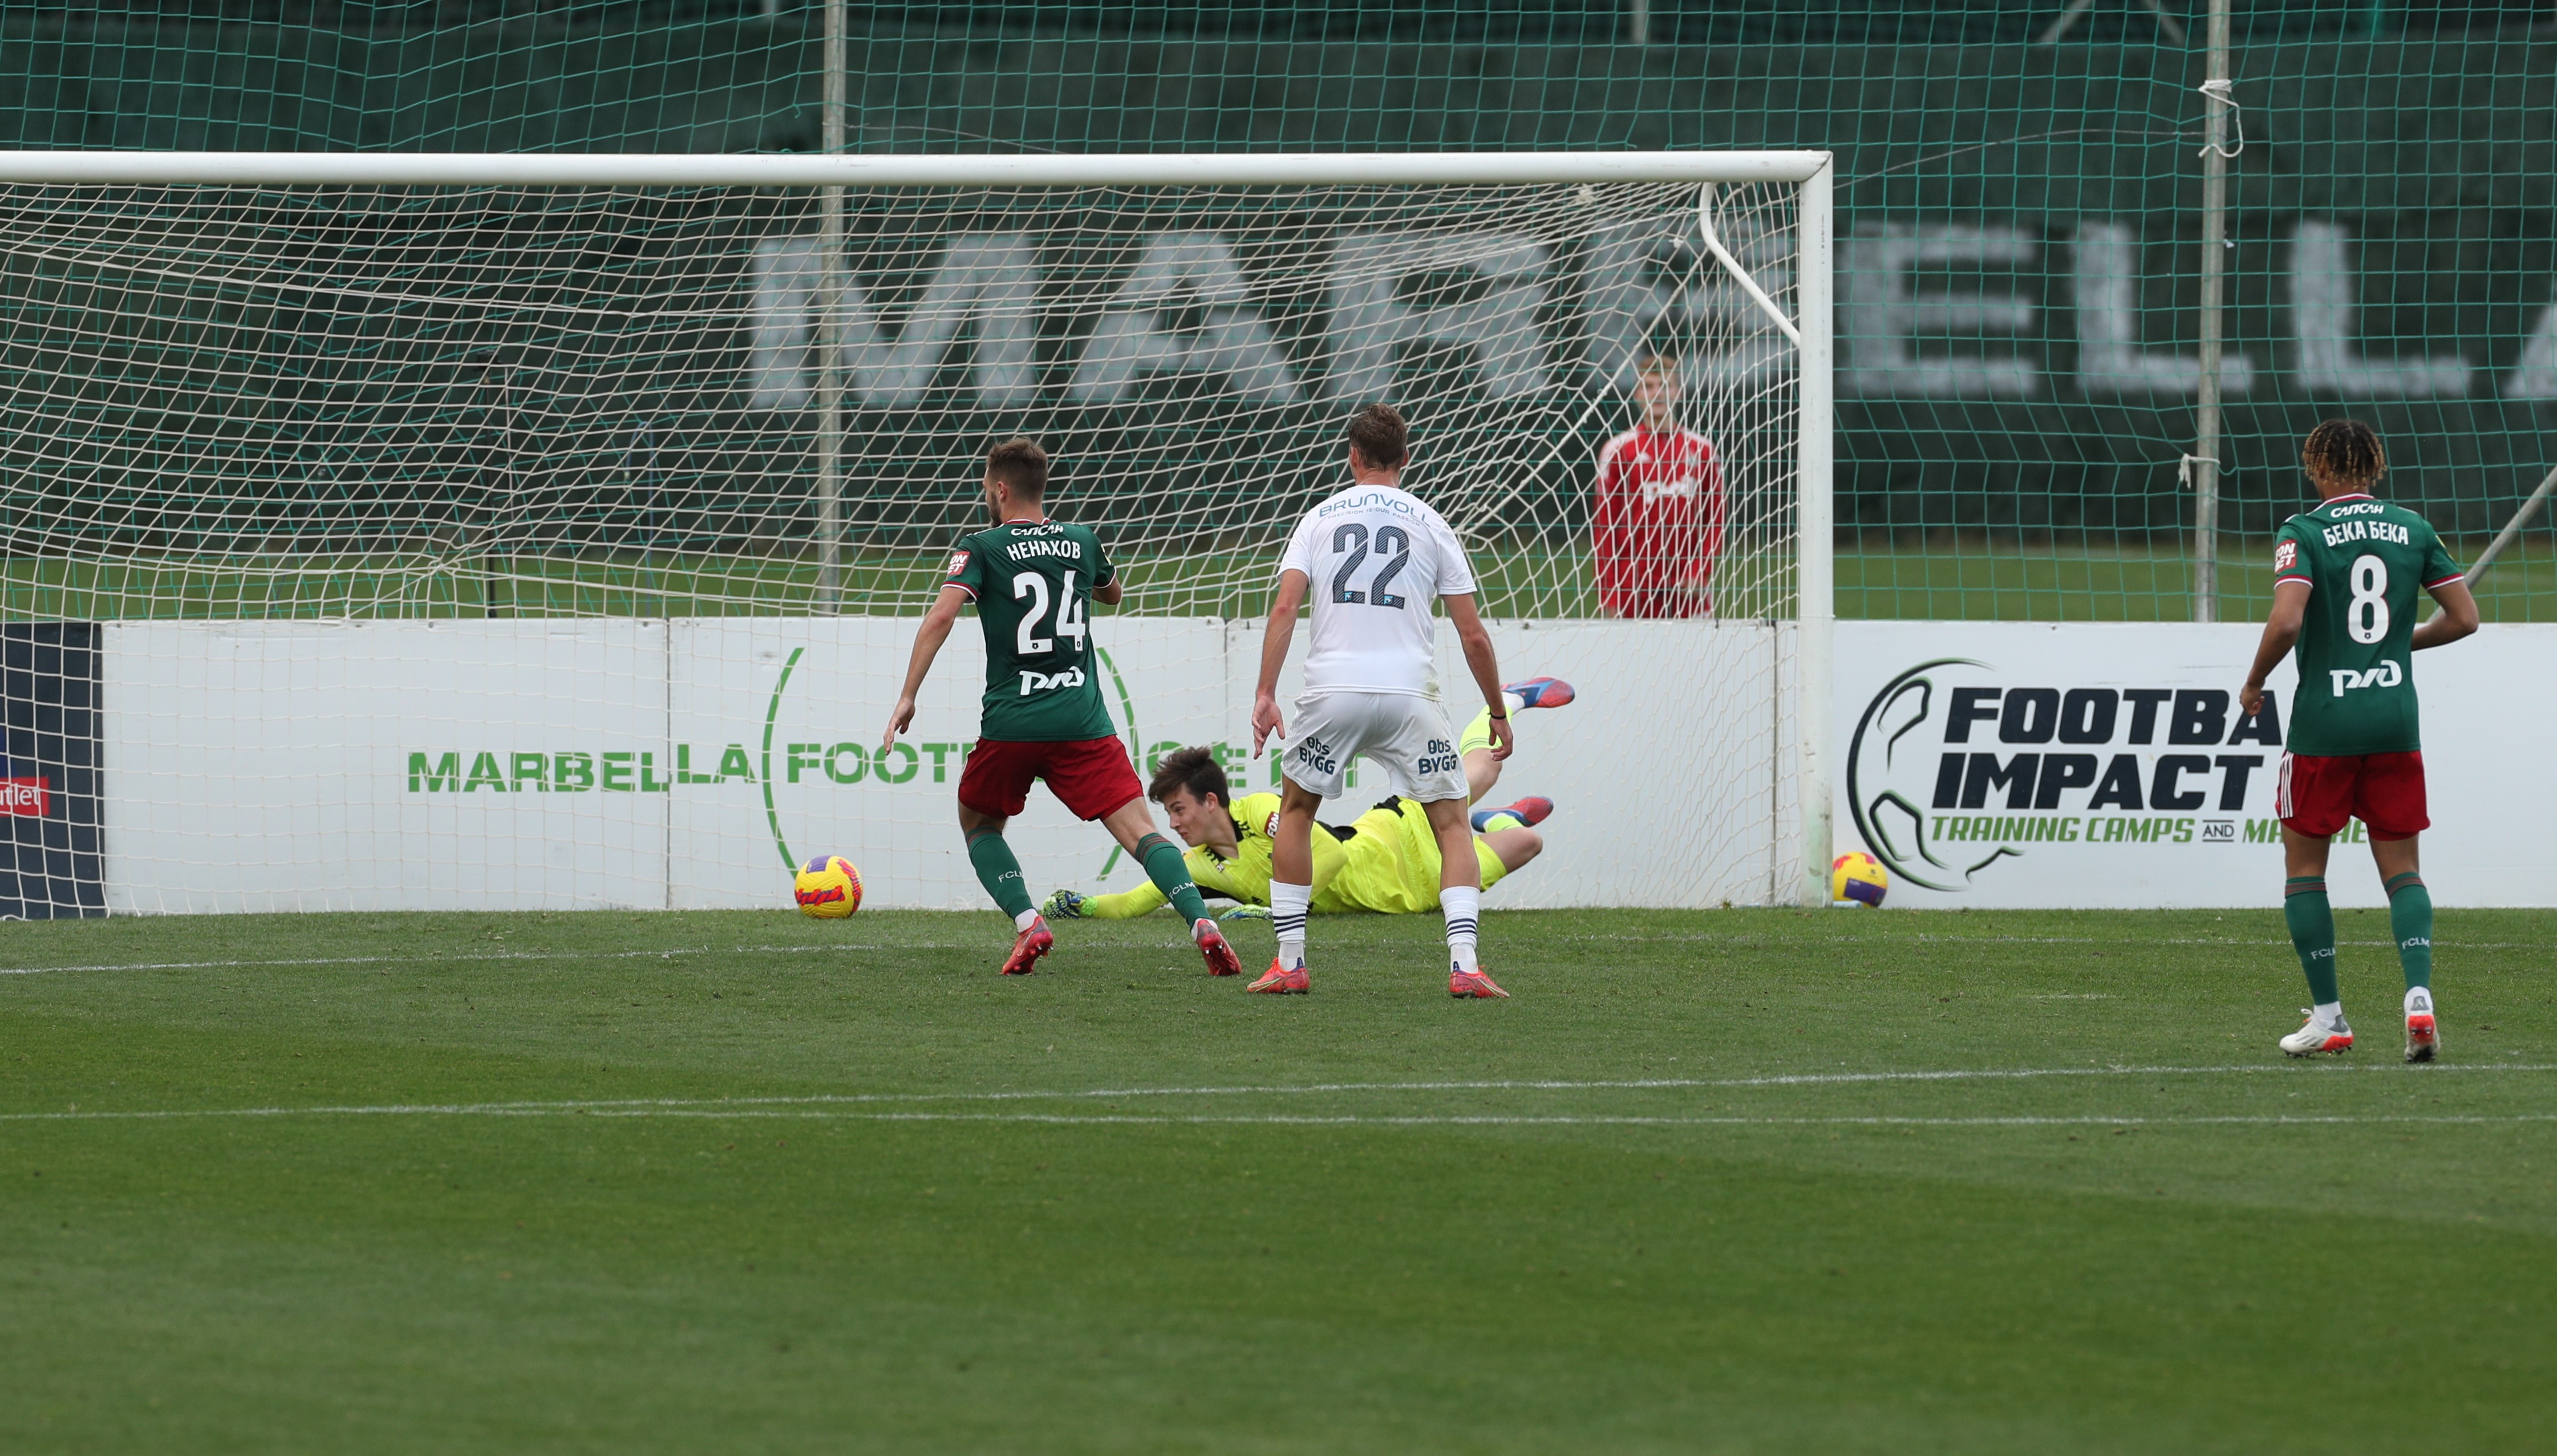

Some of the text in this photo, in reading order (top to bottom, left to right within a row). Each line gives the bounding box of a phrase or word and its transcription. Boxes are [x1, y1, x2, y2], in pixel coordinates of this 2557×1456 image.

[749, 220, 2557, 406] MARBELL
[1319, 493, 1431, 528] BRUNVOLL
[1327, 509, 1364, 520] PRECISION
[1392, 512, 1421, 527] PASSION
[2322, 520, 2409, 547] БЕКА БЕКА
[1006, 540, 1081, 561] НЕНАХОВ
[1332, 524, 1410, 610] 22
[1013, 570, 1085, 654] 24
[2348, 554, 2389, 644] 8
[408, 744, 757, 792] MARBELLA
[1299, 746, 1336, 775] BYGG
[1419, 753, 1457, 774] BYGG
[1932, 753, 2264, 810] IMPACT
[1932, 817, 2080, 841] TRAINING
[2086, 818, 2195, 843] CAMPS
[2203, 825, 2234, 837] AND
[1169, 882, 1196, 900] FCLM
[2402, 937, 2430, 950] FCLM
